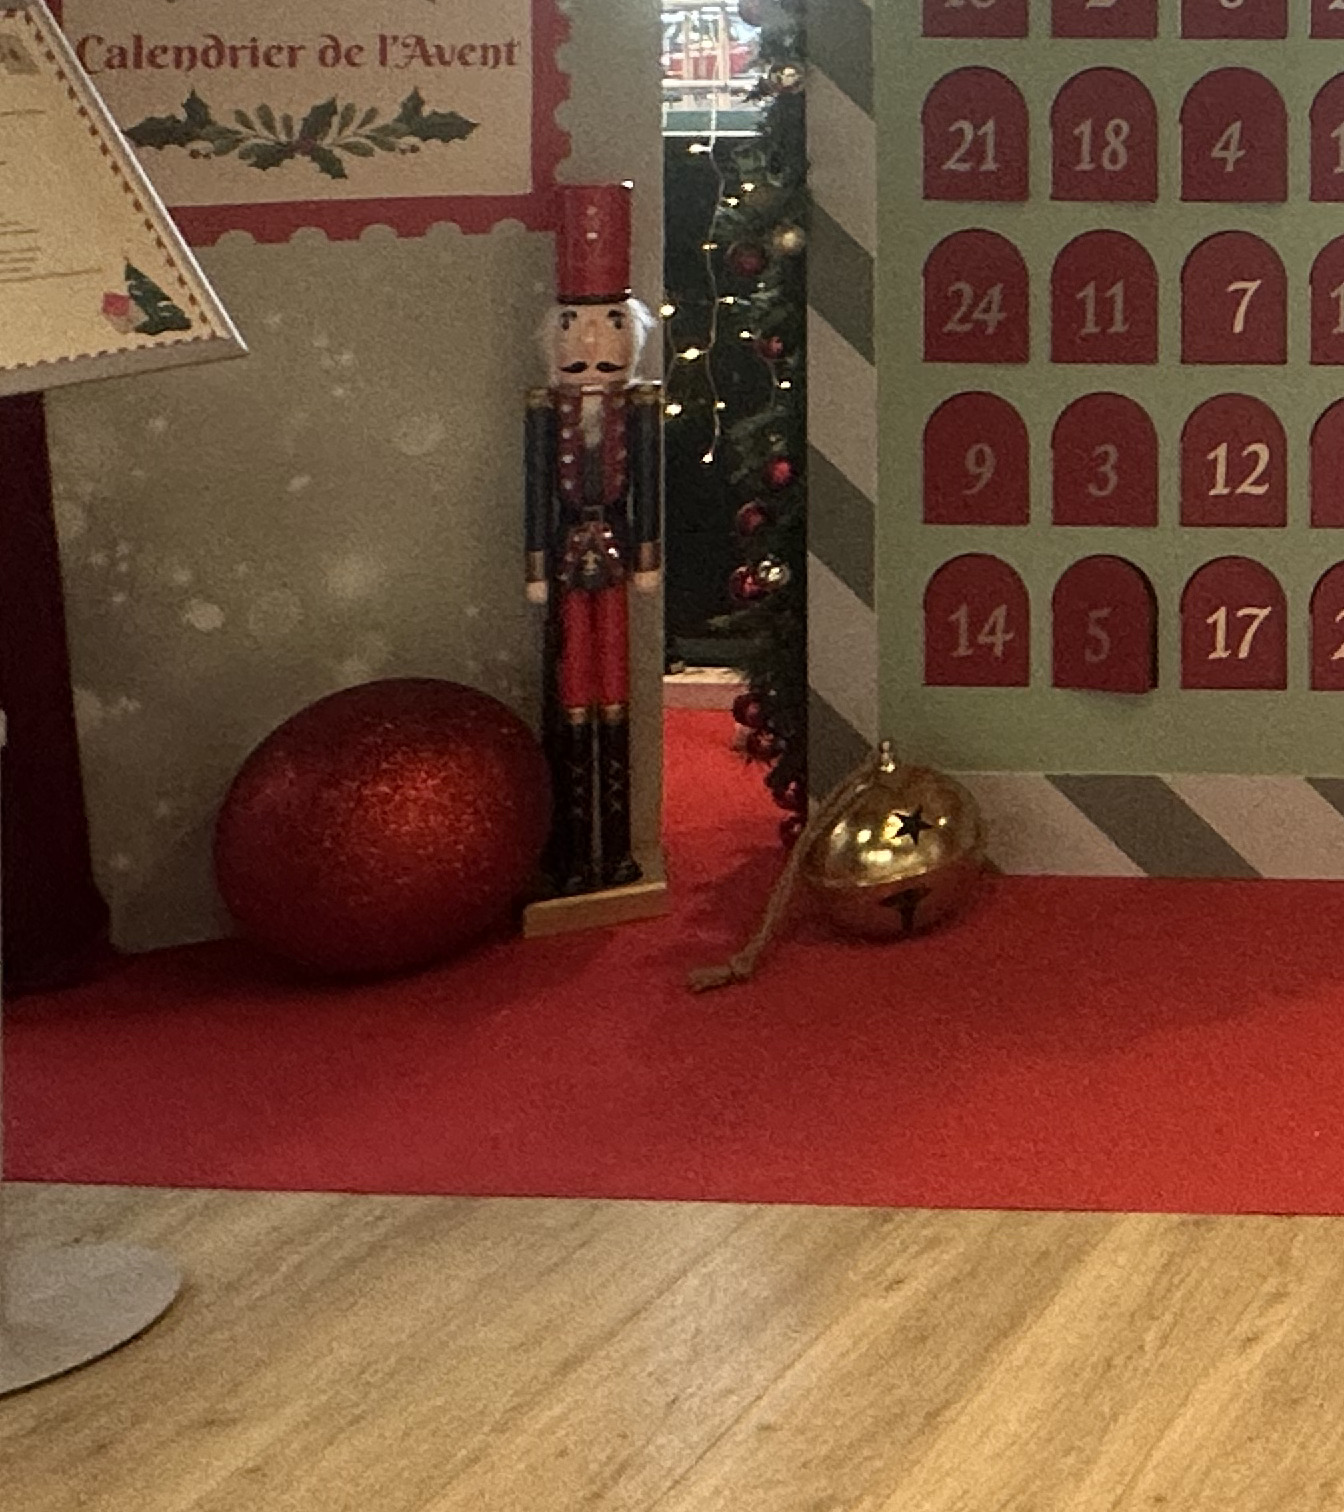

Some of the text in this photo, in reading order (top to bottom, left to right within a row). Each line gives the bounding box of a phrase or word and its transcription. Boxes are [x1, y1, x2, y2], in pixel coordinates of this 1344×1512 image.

[75, 33, 521, 74] Calendrier de l'Avent
[943, 119, 997, 171] 21
[1074, 118, 1129, 170] 18
[1211, 121, 1245, 172] 4
[944, 281, 1006, 333] 24
[1077, 281, 1128, 334] 11
[1228, 280, 1261, 333] 7
[964, 443, 996, 494] 9
[1088, 444, 1118, 496] 3
[1208, 443, 1269, 495] 12
[950, 604, 1014, 656] 14
[1085, 607, 1111, 663] 5
[1207, 607, 1271, 659] 17
